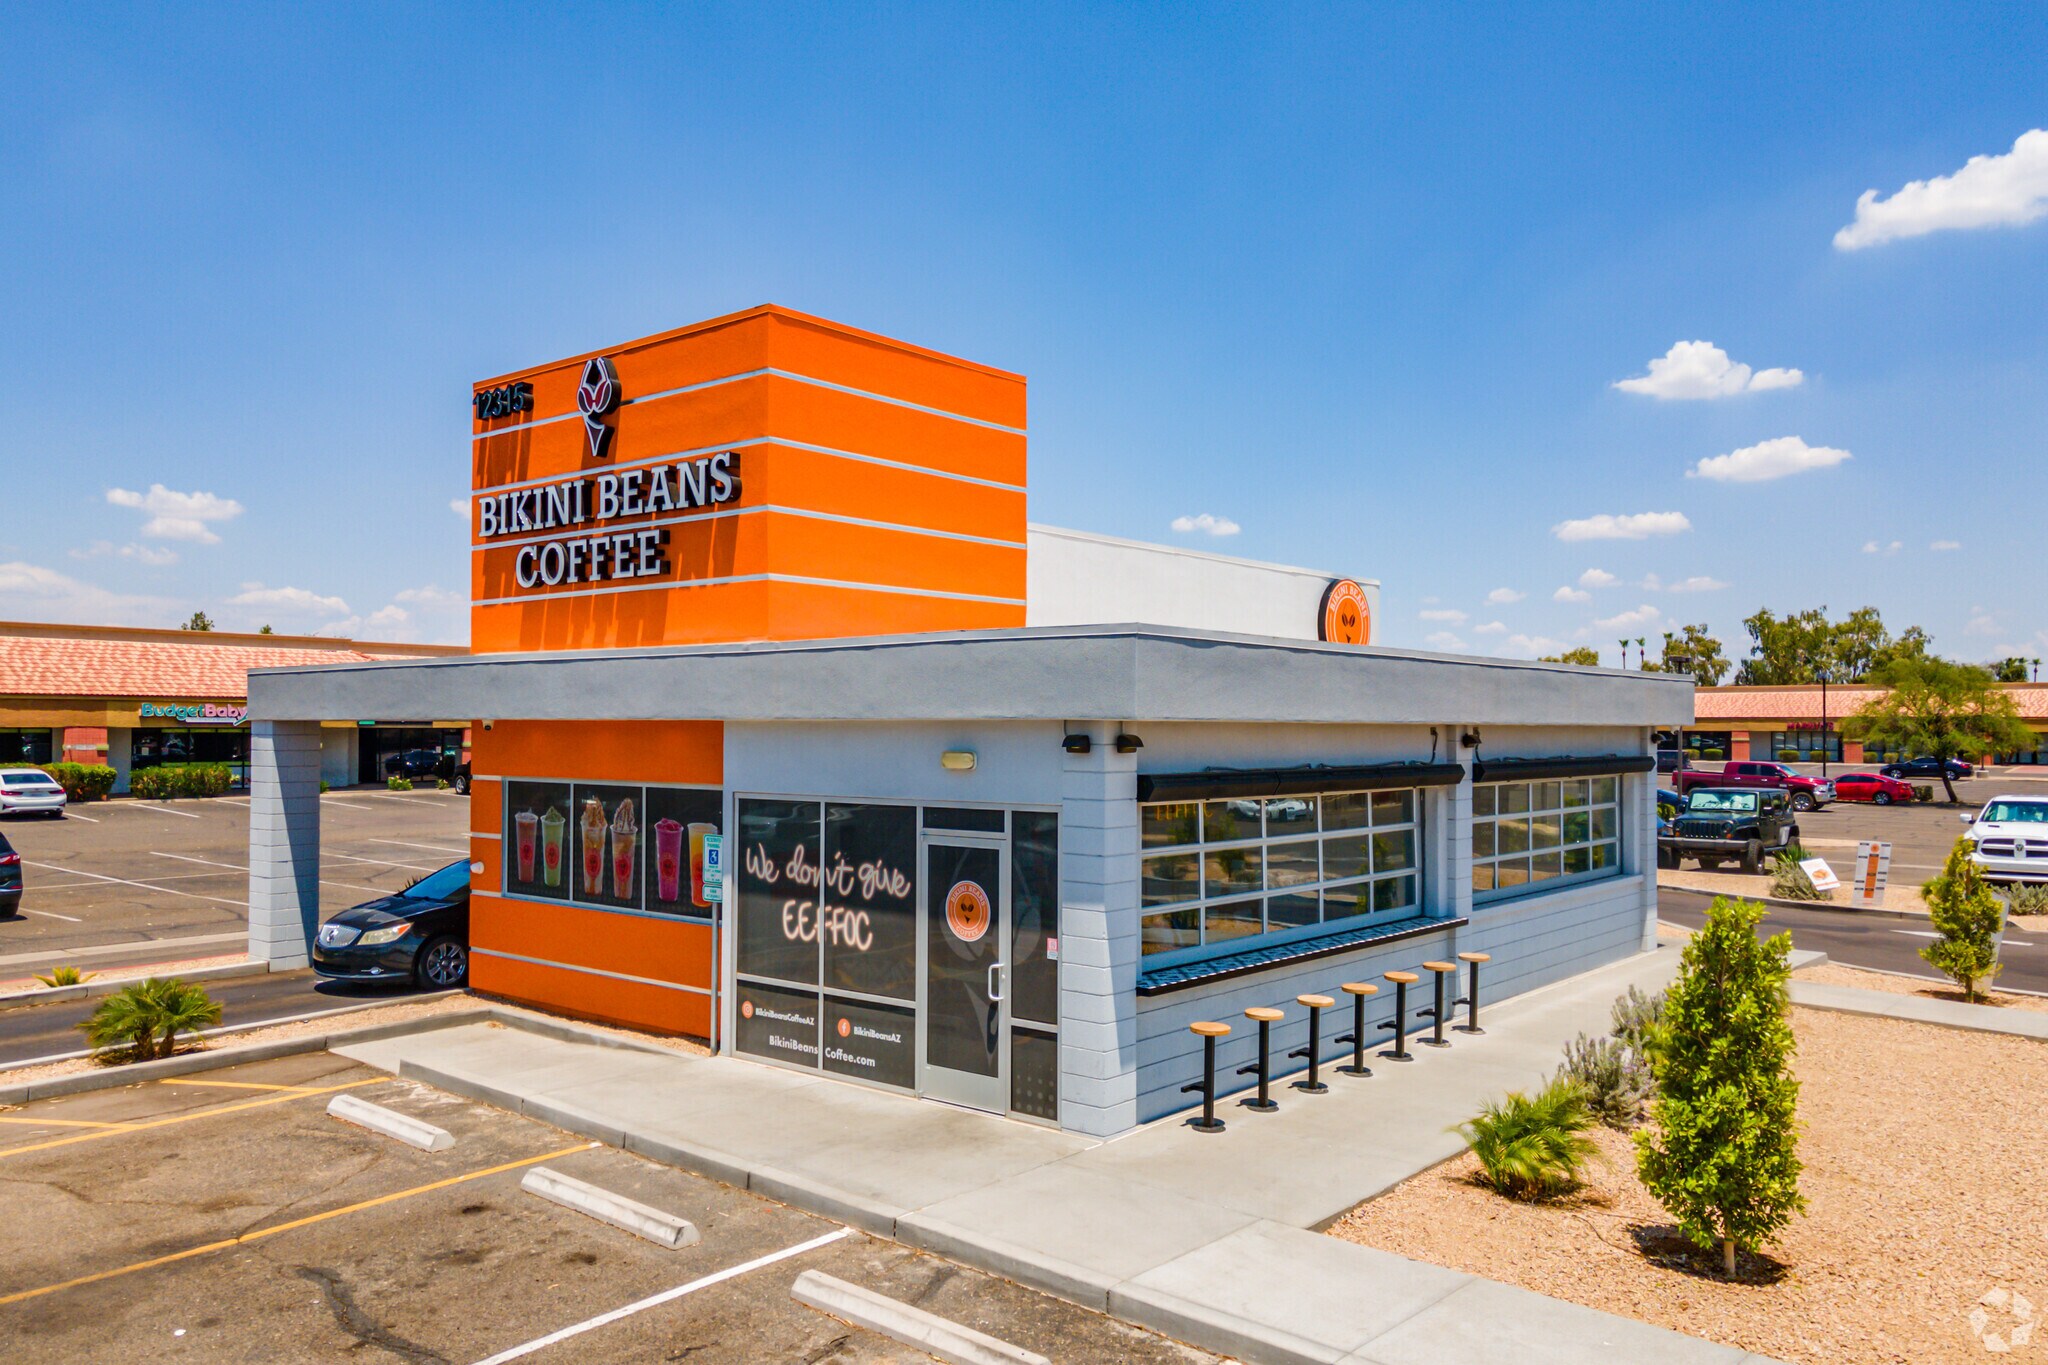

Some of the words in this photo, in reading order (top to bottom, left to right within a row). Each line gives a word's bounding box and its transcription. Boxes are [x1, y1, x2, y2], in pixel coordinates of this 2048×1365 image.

[474, 382, 526, 419] 12315
[478, 479, 587, 537] BIKINI
[597, 452, 738, 520] BEANS
[515, 529, 663, 589] COFFEE
[746, 842, 780, 883] We
[786, 844, 855, 896] don't
[858, 859, 911, 900] give
[782, 900, 873, 951] EEFFOC
[755, 1008, 815, 1026] BikiniBeansCoffeeAZ
[853, 1026, 902, 1043] BikiniBeansAZ
[769, 1035, 819, 1055] BikiniBeans
[824, 1047, 876, 1068] Coffee.com
